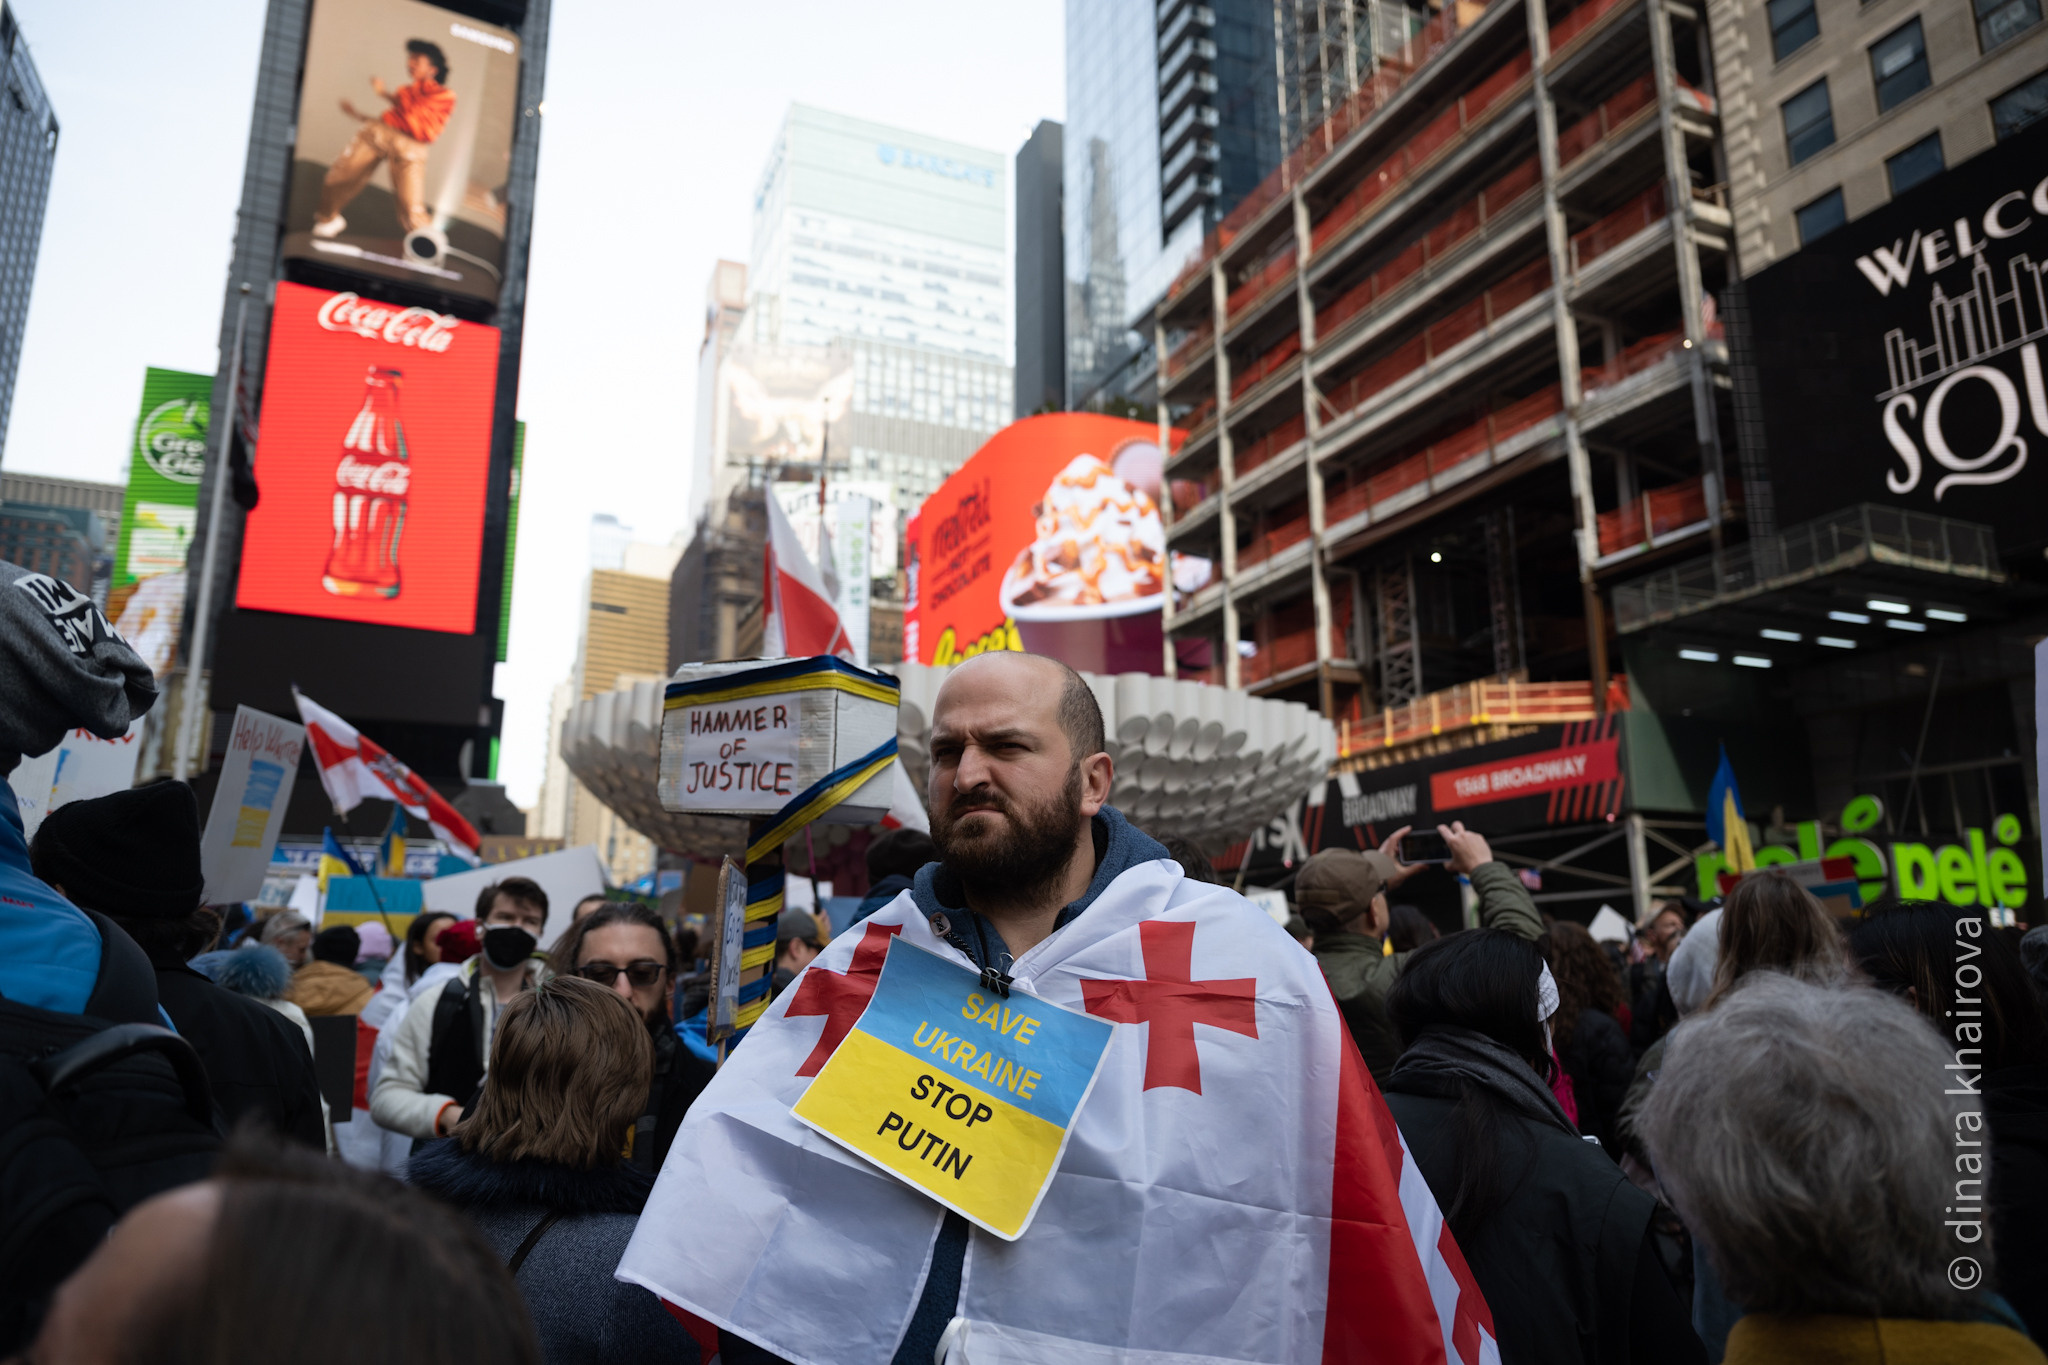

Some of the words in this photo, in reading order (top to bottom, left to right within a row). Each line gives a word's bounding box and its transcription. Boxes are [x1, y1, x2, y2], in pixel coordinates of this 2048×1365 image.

[691, 704, 788, 736] HAMMER
[720, 738, 747, 760] OF
[687, 761, 793, 796] JUSTICE
[1490, 754, 1587, 792] BROADWAY
[1342, 784, 1418, 828] BROADWAY
[962, 993, 1041, 1045] SAVE
[913, 1021, 1042, 1100] UKRAINE
[910, 1074, 993, 1128] STOP
[876, 1111, 973, 1180] PUTIN
